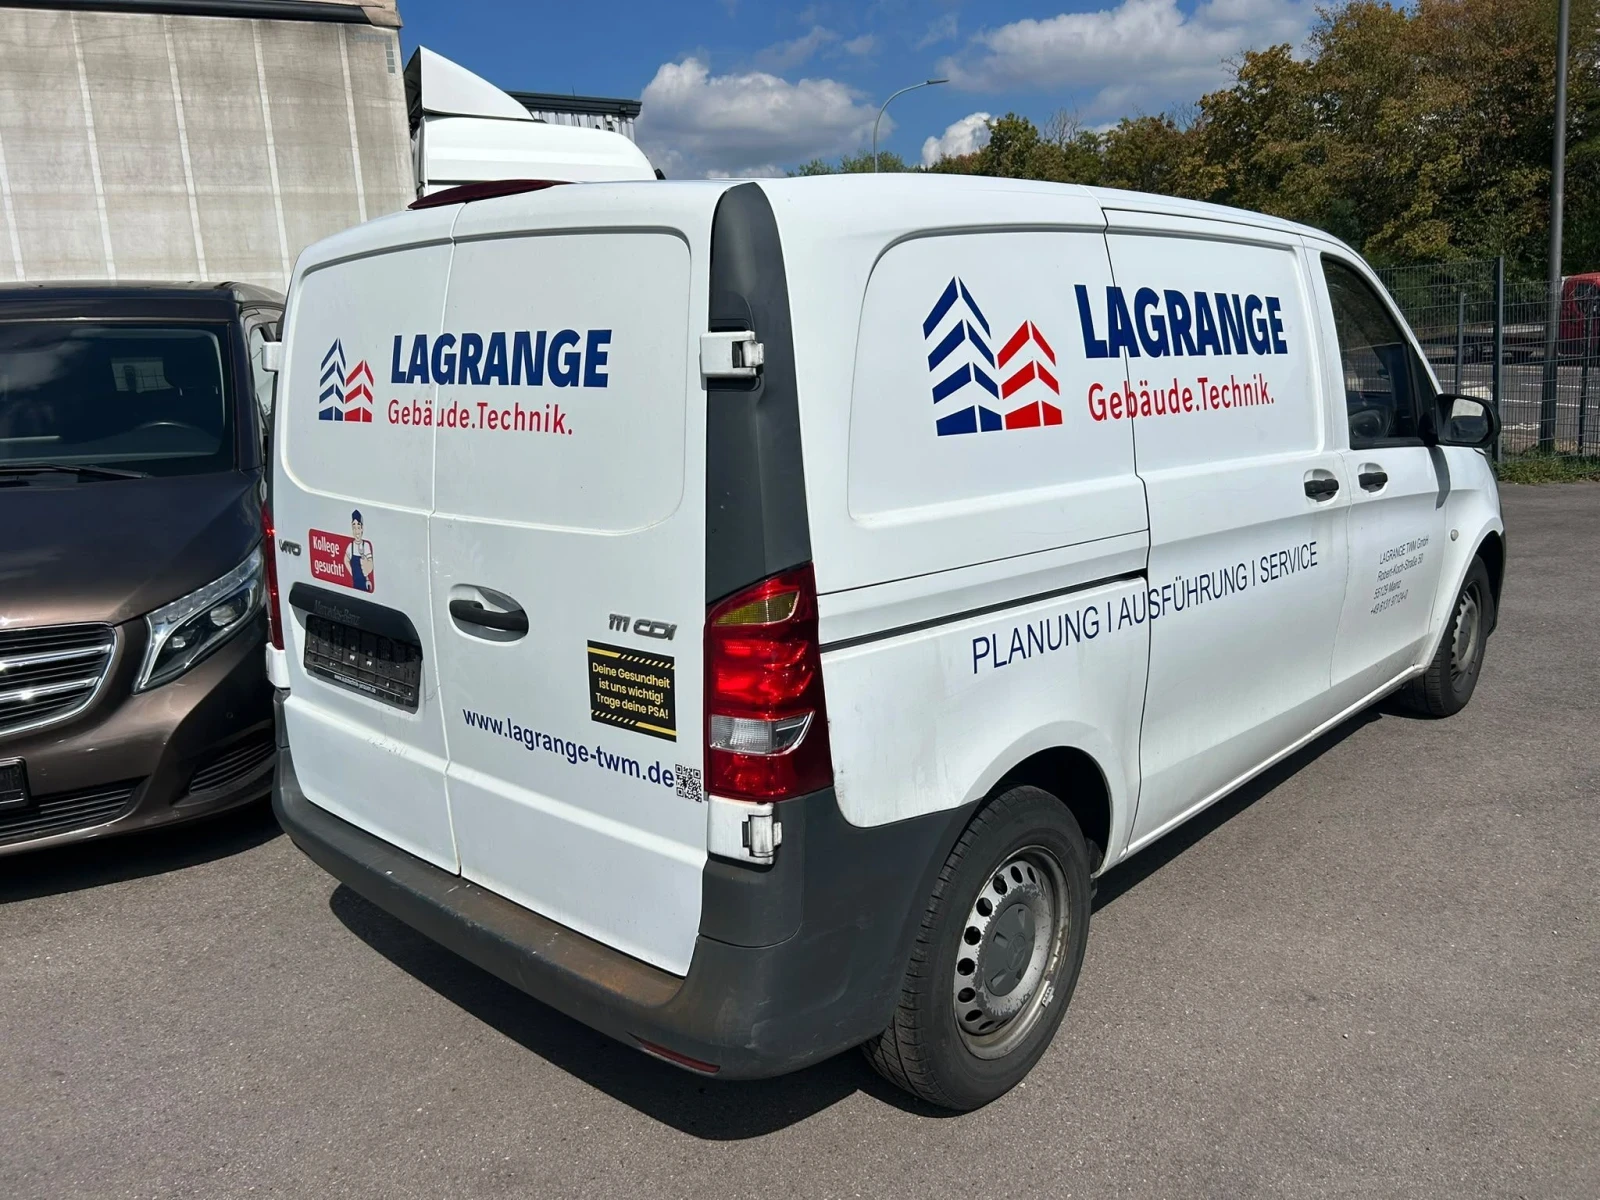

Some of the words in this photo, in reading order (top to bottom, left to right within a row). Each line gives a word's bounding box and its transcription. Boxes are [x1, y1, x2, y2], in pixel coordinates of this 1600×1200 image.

[1073, 284, 1288, 359] LAGRANGE
[390, 329, 612, 388] LAGRANGE
[1087, 373, 1275, 422] Gebäude.Technik.
[388, 399, 573, 435] Gebäude.Technik.
[312, 535, 340, 557] Kollege
[1379, 543, 1406, 565] LAGRANGE
[314, 559, 345, 578] gesucht!
[972, 606, 1100, 674] PLANUNG
[1118, 563, 1247, 630] AUSFÜHRUNG
[1260, 541, 1318, 583] SERVICE
[633, 618, 678, 641] CDI
[592, 662, 617, 677] Deine
[617, 667, 671, 689] Gesundheit
[598, 678, 610, 690] ist
[610, 682, 627, 695] uns
[627, 685, 664, 705] wichtig!
[595, 692, 620, 708] Trage
[621, 699, 647, 714] deine
[648, 705, 669, 720] PSA!
[463, 709, 675, 788] www.lagrange-twm.de
